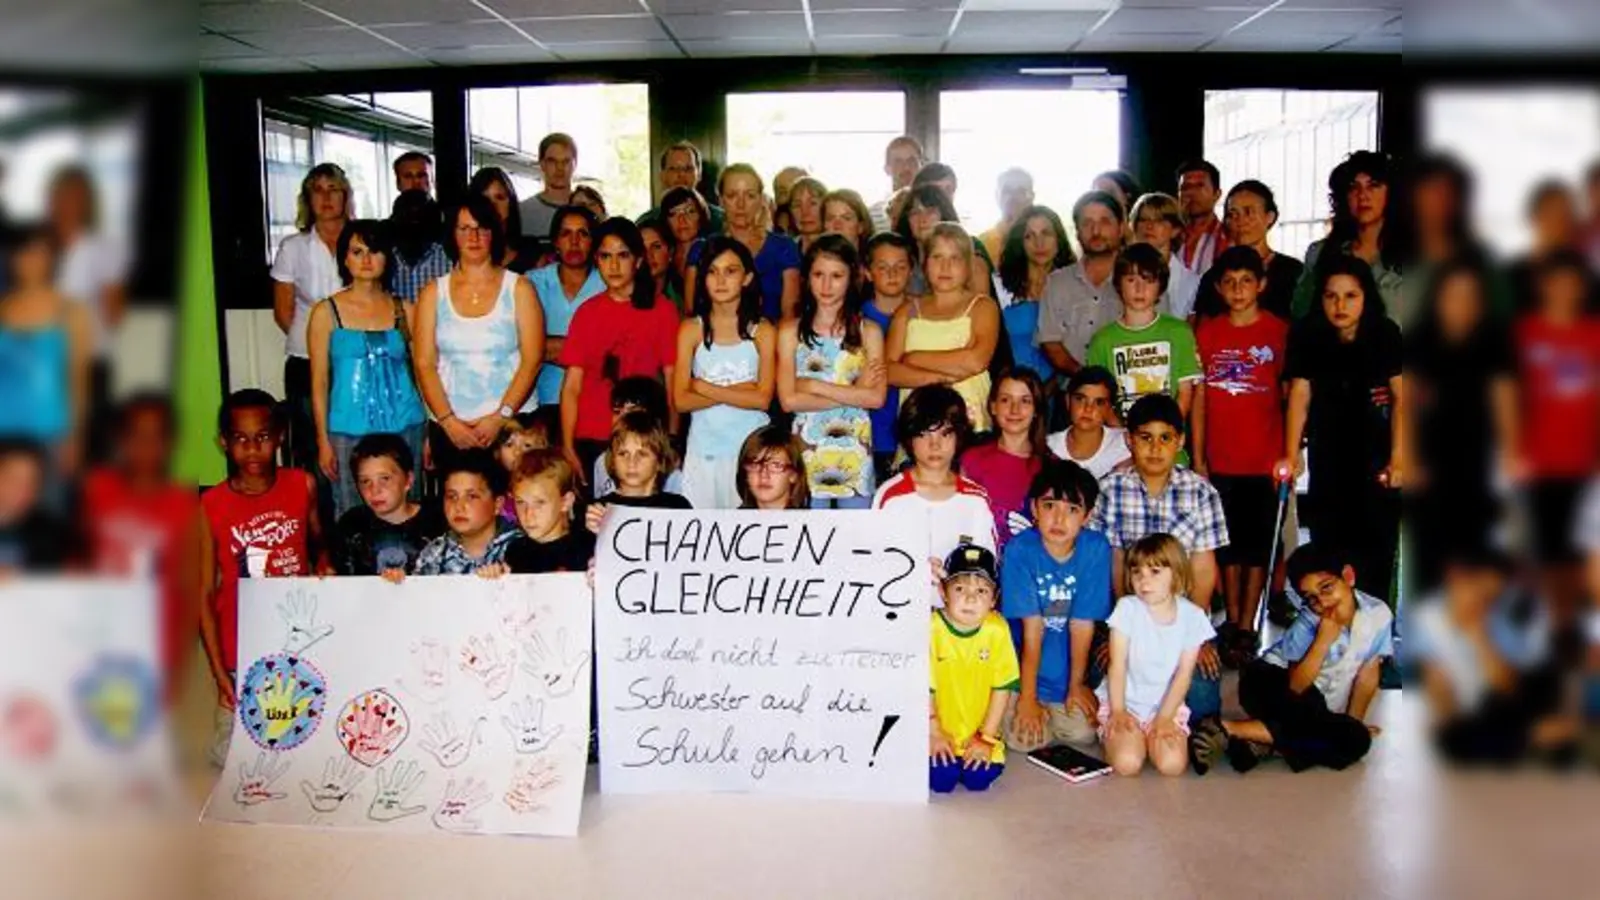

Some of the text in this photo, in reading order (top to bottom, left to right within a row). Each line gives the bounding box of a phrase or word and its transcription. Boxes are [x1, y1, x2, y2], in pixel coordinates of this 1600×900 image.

[613, 518, 836, 565] CHANCEN
[711, 637, 779, 667] nicht
[615, 675, 873, 715] Schwester auf die
[622, 725, 739, 768] Schule
[750, 731, 849, 781] gehen
